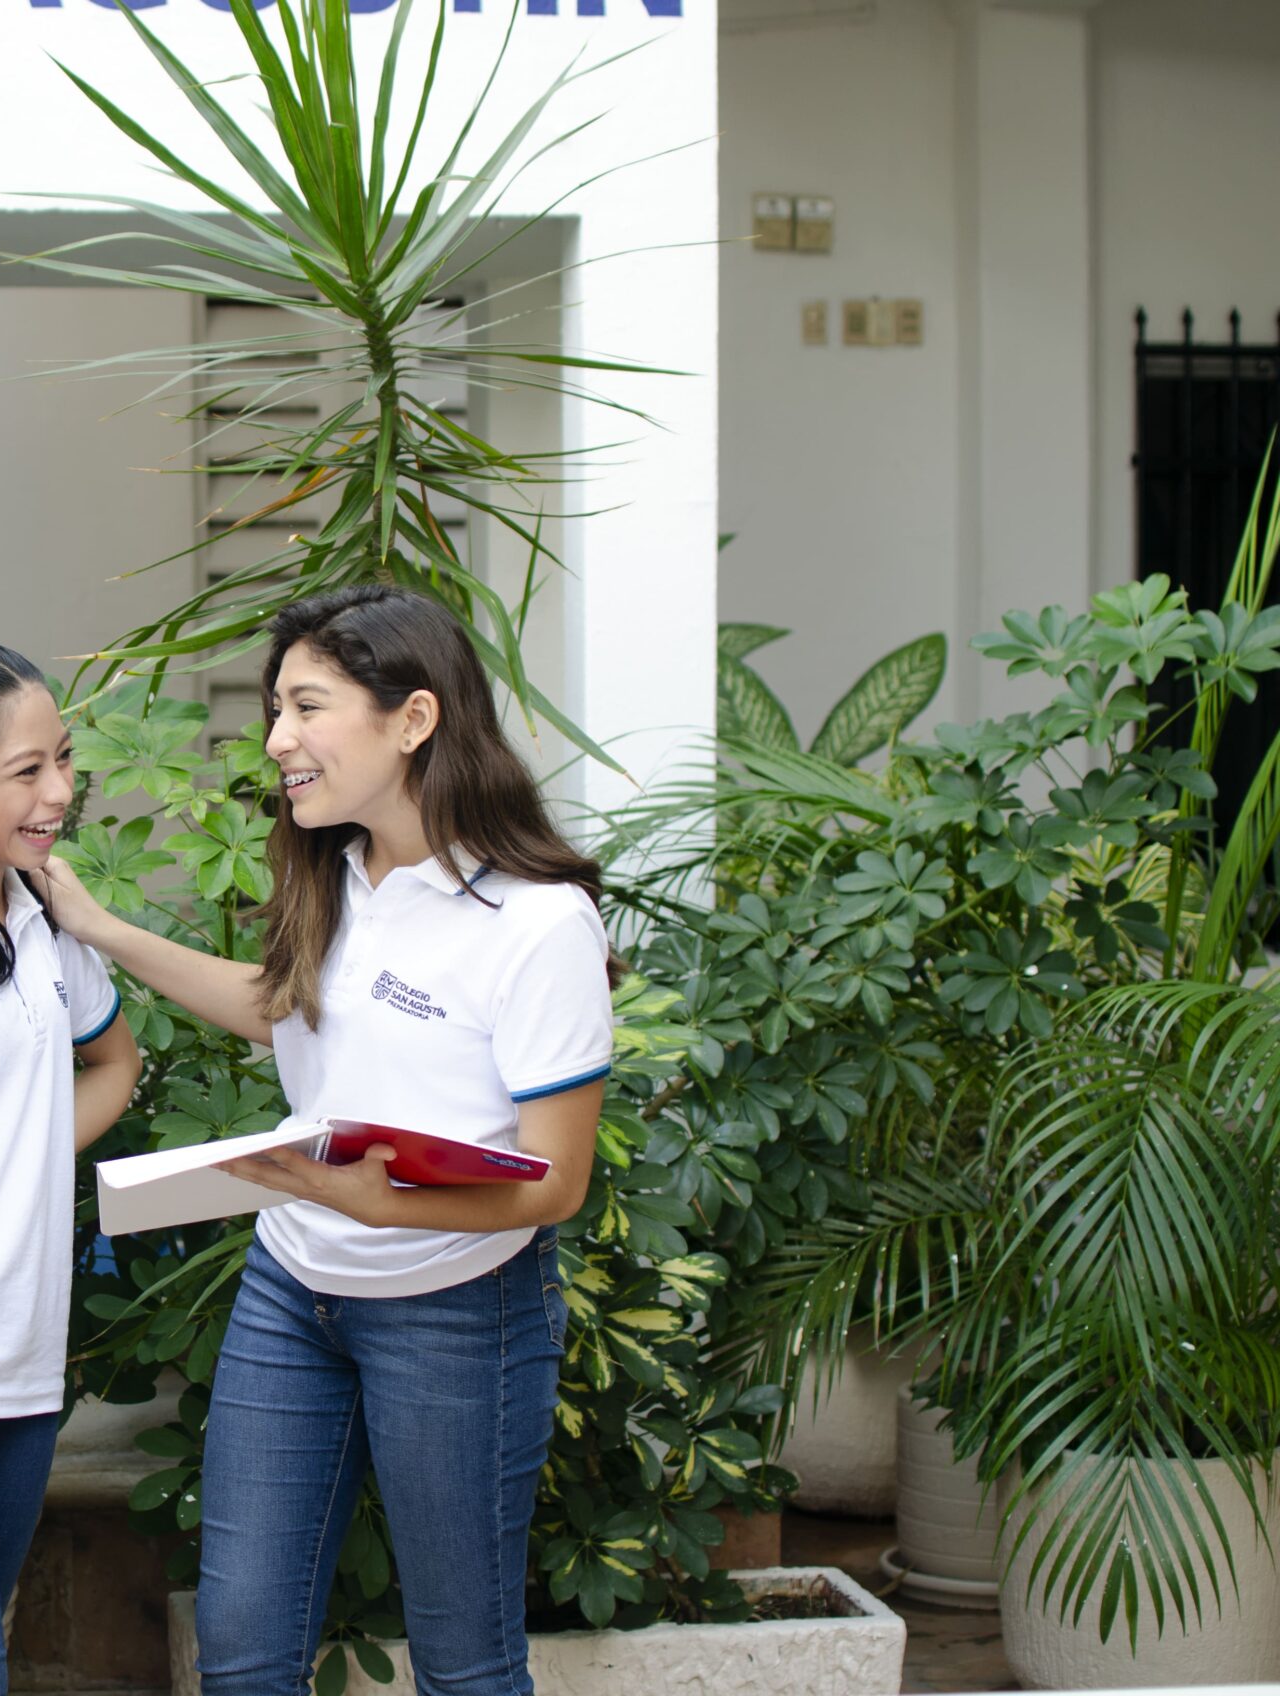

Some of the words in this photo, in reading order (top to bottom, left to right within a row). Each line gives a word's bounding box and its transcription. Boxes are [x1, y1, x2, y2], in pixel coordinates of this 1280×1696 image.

[395, 981, 431, 1002] COLEGIO
[390, 990, 409, 1005] SAN
[408, 999, 447, 1019] AGUSTÍN
